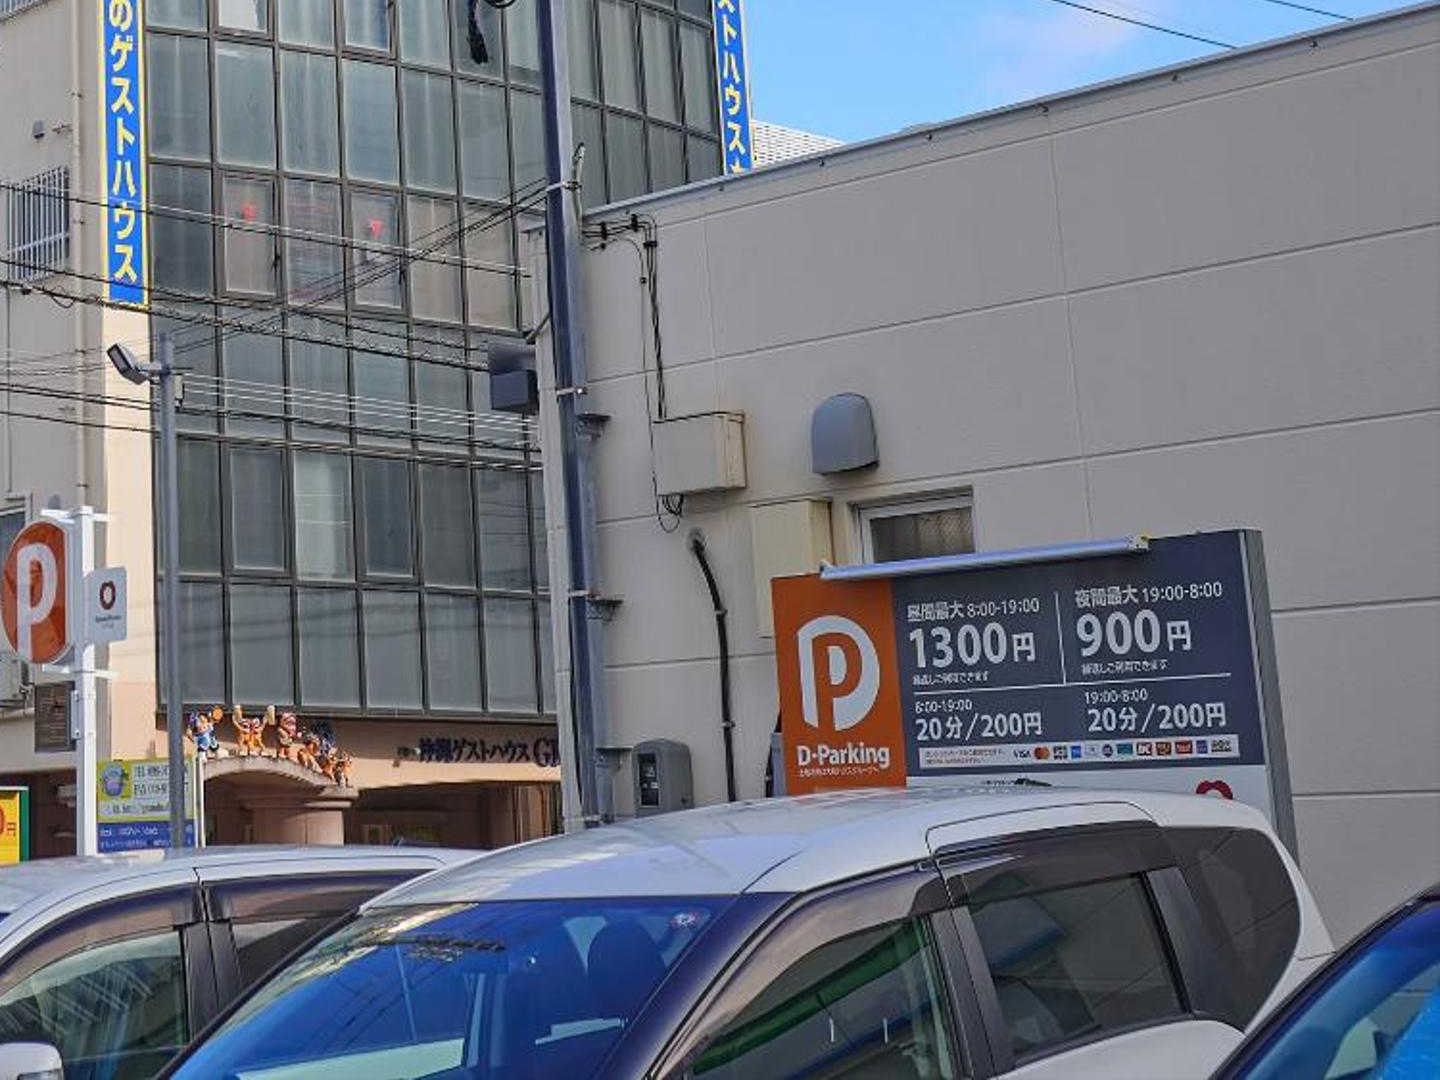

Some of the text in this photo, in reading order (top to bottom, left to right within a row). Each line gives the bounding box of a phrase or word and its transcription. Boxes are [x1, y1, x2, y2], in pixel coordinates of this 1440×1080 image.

[17, 542, 58, 664] P
[1075, 581, 1223, 608] 夜間最大 19:00-8:00
[967, 597, 1040, 618] 8:00-19:00
[1084, 688, 1148, 705] 19:00-8:00
[796, 741, 891, 769] D-Parking
[1013, 749, 1032, 759] VISA
